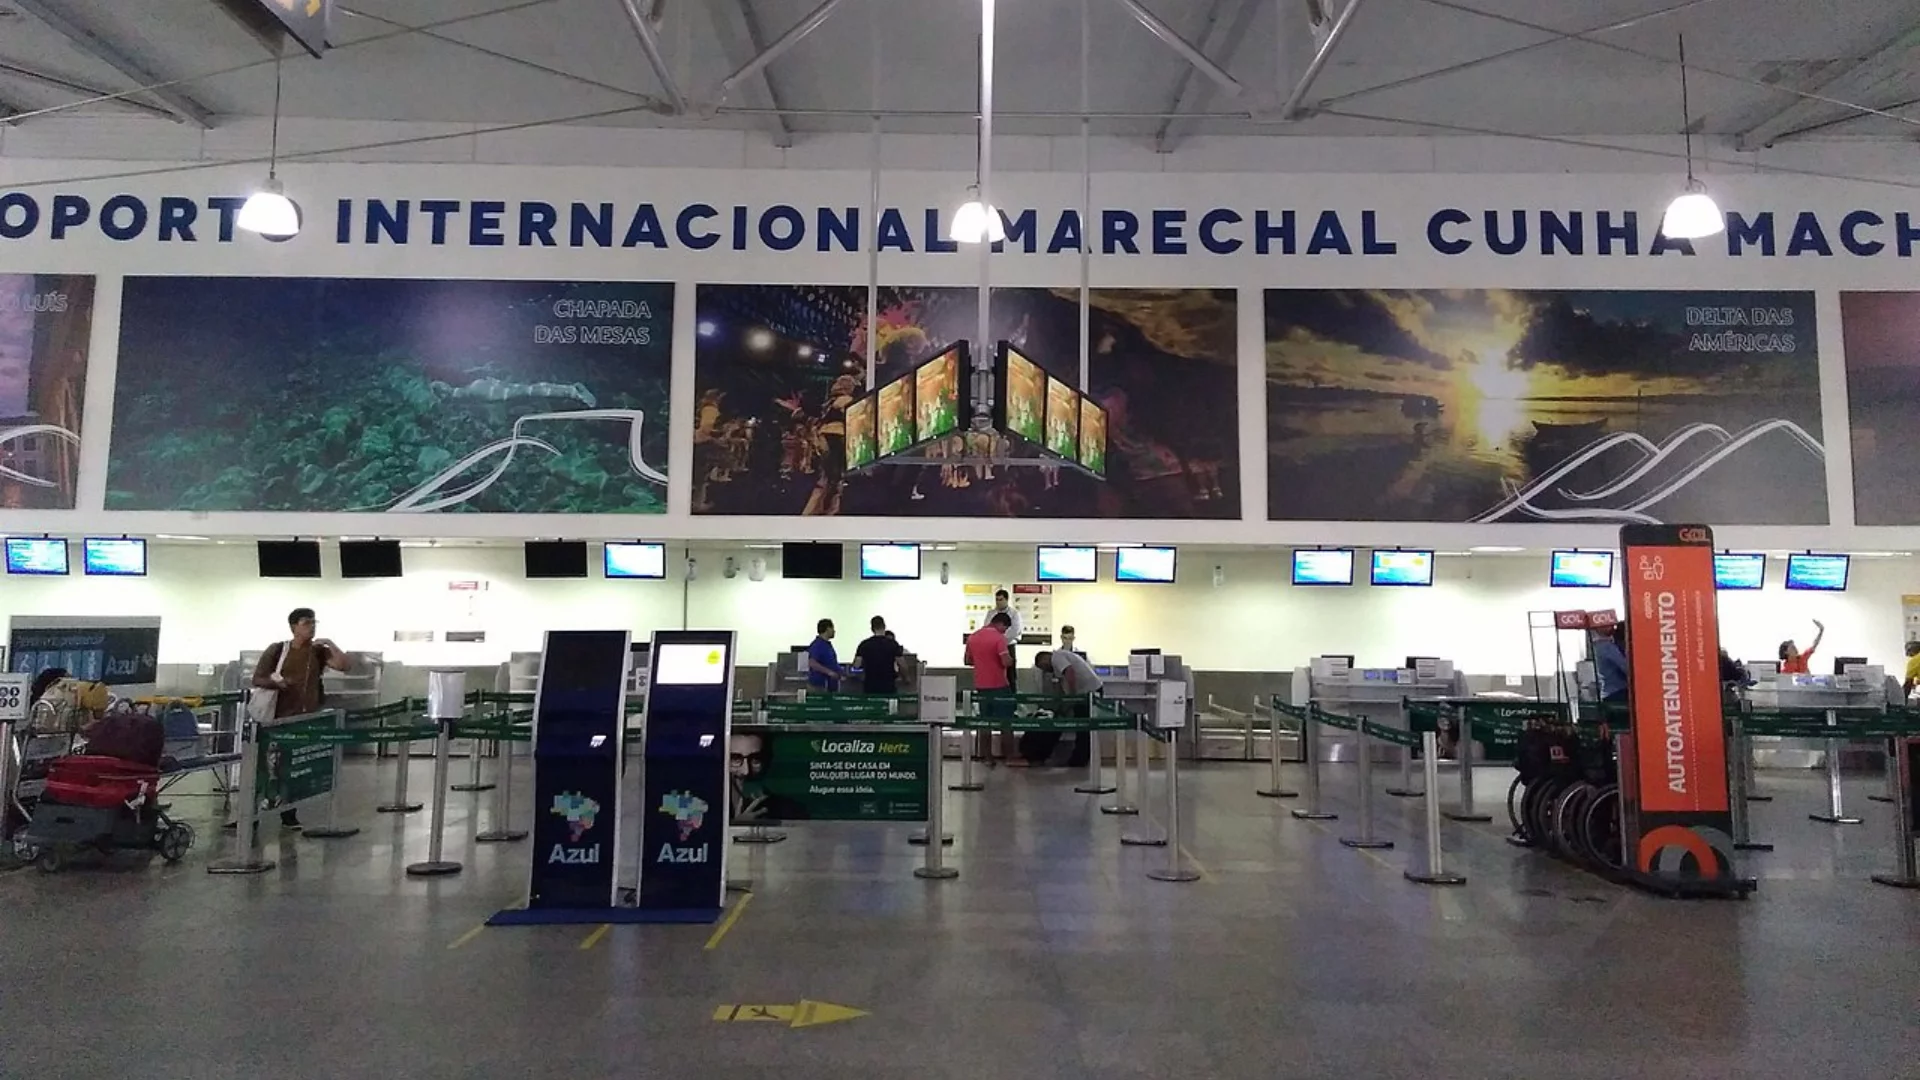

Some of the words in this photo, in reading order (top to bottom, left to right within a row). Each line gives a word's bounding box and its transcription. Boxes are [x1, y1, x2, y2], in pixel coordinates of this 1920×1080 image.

[0, 192, 303, 242] OPORT
[337, 198, 958, 253] INTERNACIONAL
[991, 209, 1397, 254] MARECHAL
[553, 299, 652, 319] CHAPADA
[1686, 306, 1748, 326] DELTA
[1751, 307, 1794, 326] DAS
[535, 325, 577, 344] DAS
[580, 325, 650, 345] MESAS
[1688, 330, 1796, 352] AMÉRICAS
[1679, 528, 1710, 542] GOL
[1560, 614, 1583, 624] GOL
[1592, 613, 1615, 624] GOL
[1658, 591, 1687, 795] AUTOATENDIMENTO
[821, 739, 875, 753] Localiza
[878, 742, 910, 754] Hertz
[809, 771, 849, 780] QUALQUER
[851, 771, 875, 780] LUGAR
[877, 771, 887, 780] DO
[810, 762, 843, 770] SINTA-SE
[845, 762, 856, 770] EM
[858, 762, 877, 770] CASA
[879, 762, 891, 770] EM
[809, 785, 835, 795] Alugue
[837, 786, 854, 794] essa
[548, 843, 600, 863] Azul
[656, 842, 709, 863] Azul
